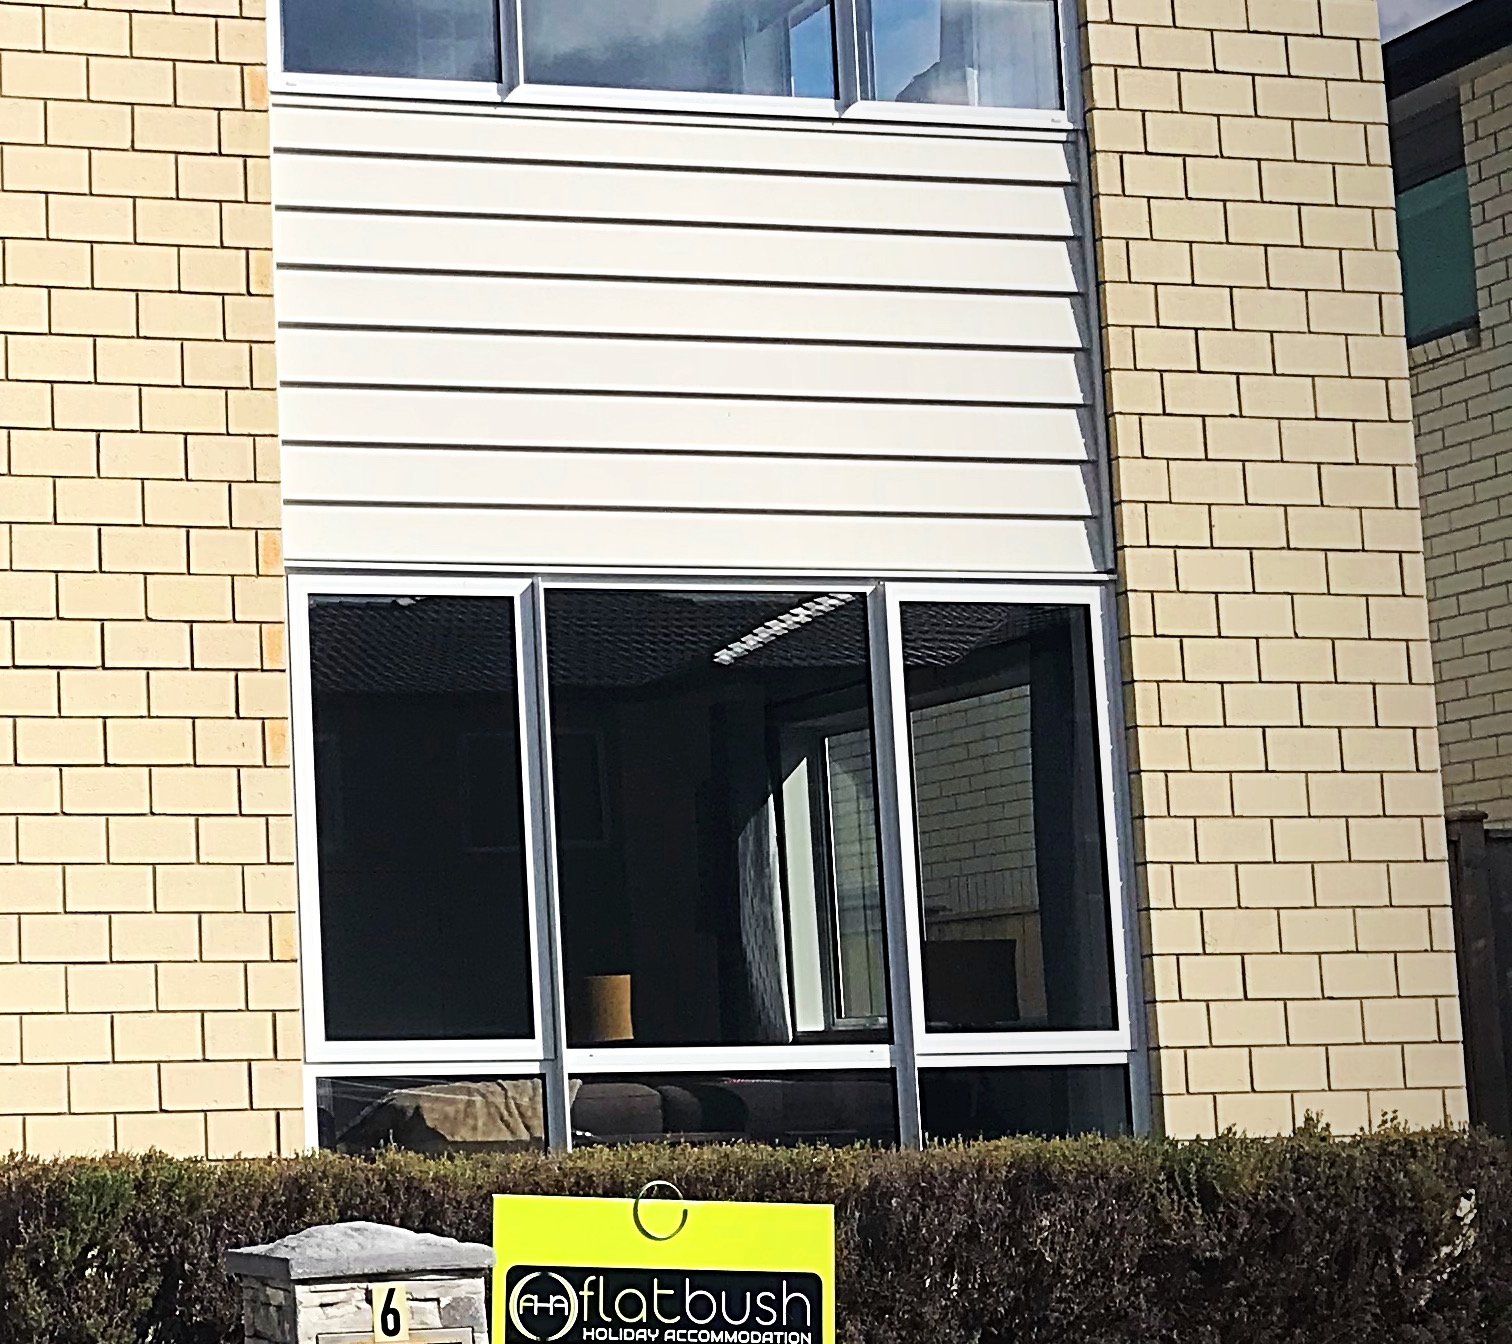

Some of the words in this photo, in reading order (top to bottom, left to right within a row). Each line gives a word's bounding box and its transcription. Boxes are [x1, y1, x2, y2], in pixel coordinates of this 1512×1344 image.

[380, 1287, 401, 1337] 6
[579, 1275, 811, 1327] flatbush
[582, 1327, 660, 1342] HOLIDAY
[663, 1330, 812, 1344] ACCOMMODATION
